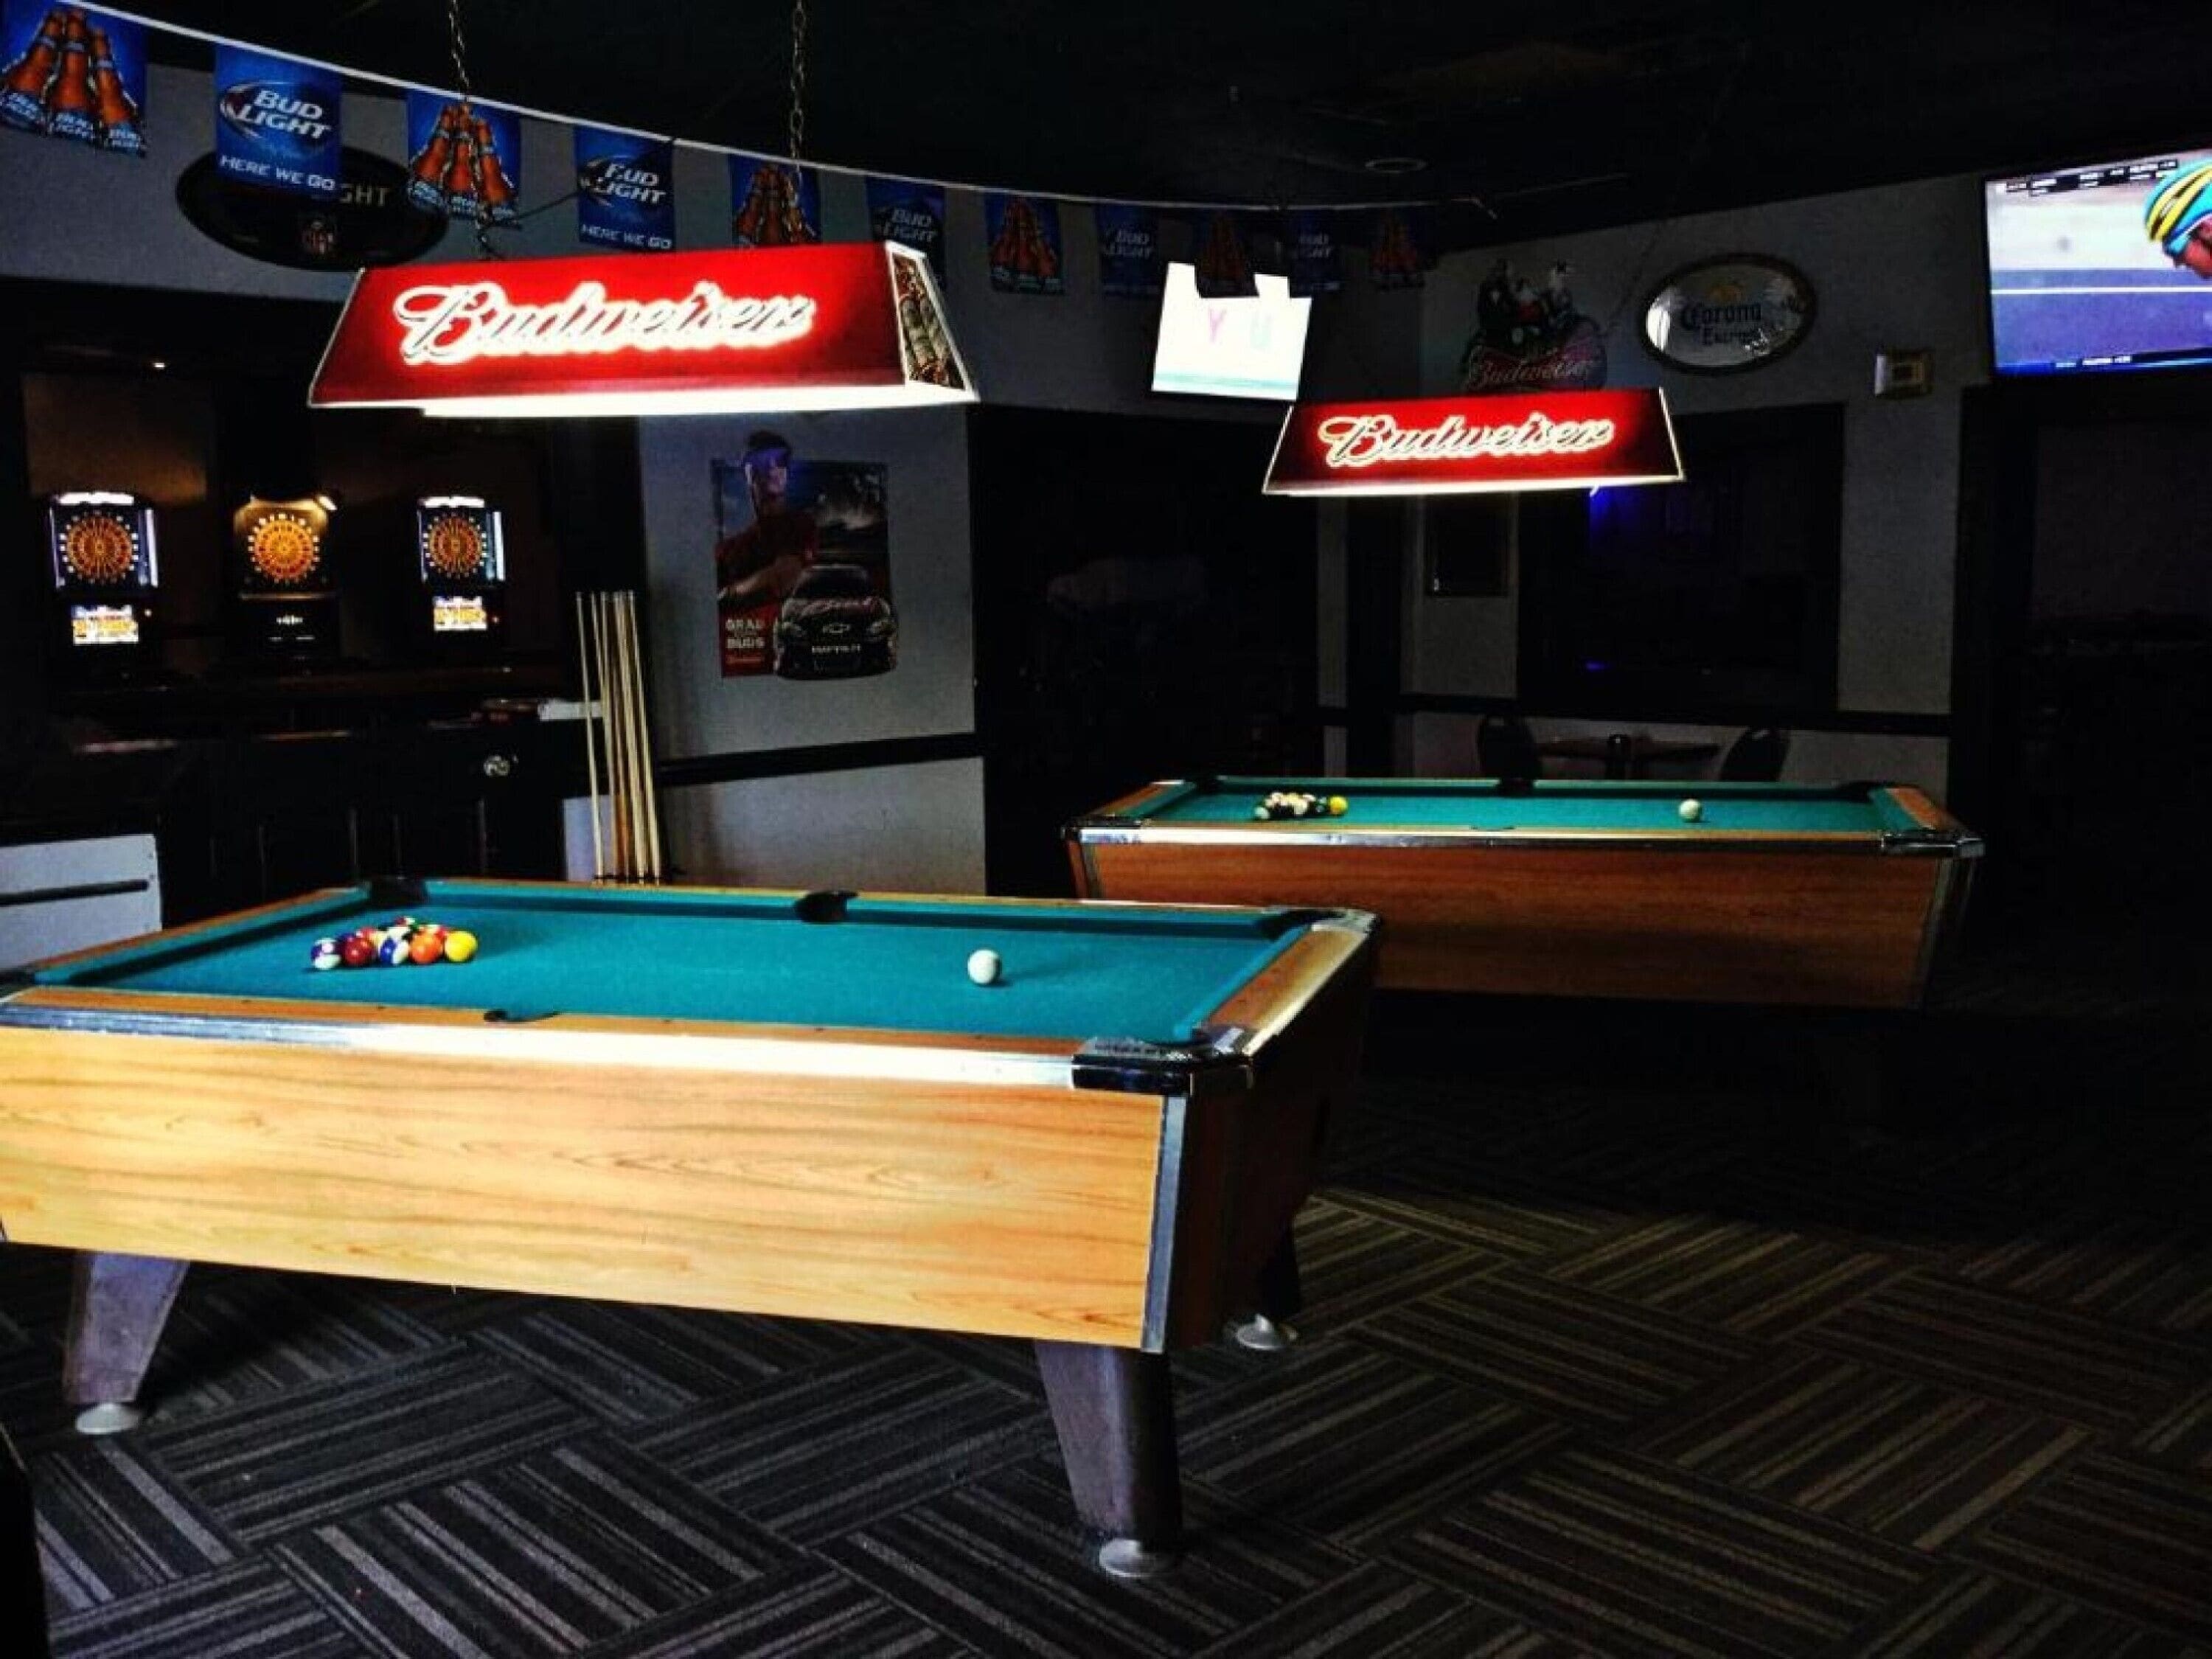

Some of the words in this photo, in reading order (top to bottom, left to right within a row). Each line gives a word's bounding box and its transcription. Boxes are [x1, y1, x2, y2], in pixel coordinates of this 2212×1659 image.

[242, 105, 332, 139] LIGHT
[254, 90, 324, 120] BUD
[220, 155, 271, 175] HERE
[275, 167, 305, 185] WE
[307, 174, 336, 191] GO
[393, 281, 817, 366] Budweiser
[1318, 412, 1614, 468] Budweiser
